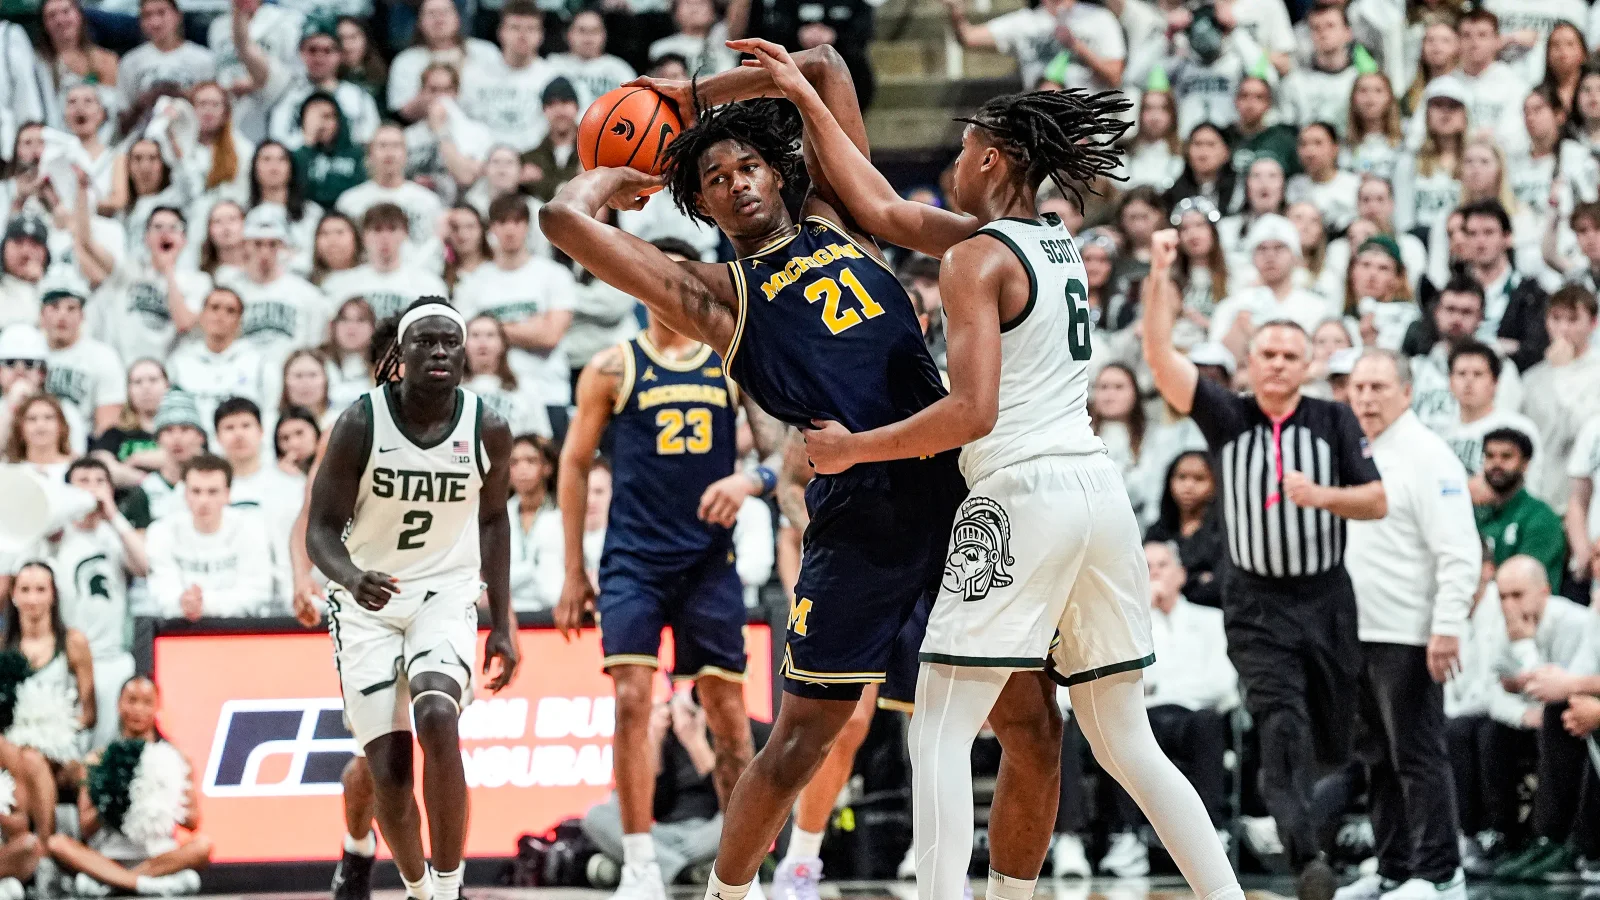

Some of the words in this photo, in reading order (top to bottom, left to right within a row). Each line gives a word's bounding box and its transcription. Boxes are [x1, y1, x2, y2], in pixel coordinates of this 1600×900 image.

[760, 243, 864, 302] MICHIGAN
[1040, 239, 1081, 263] SCOTT
[803, 267, 886, 335] 21
[1065, 278, 1092, 361] 6
[655, 408, 713, 455] 23
[372, 467, 470, 502] STATE
[397, 510, 433, 550] 2
[787, 594, 813, 637] M
